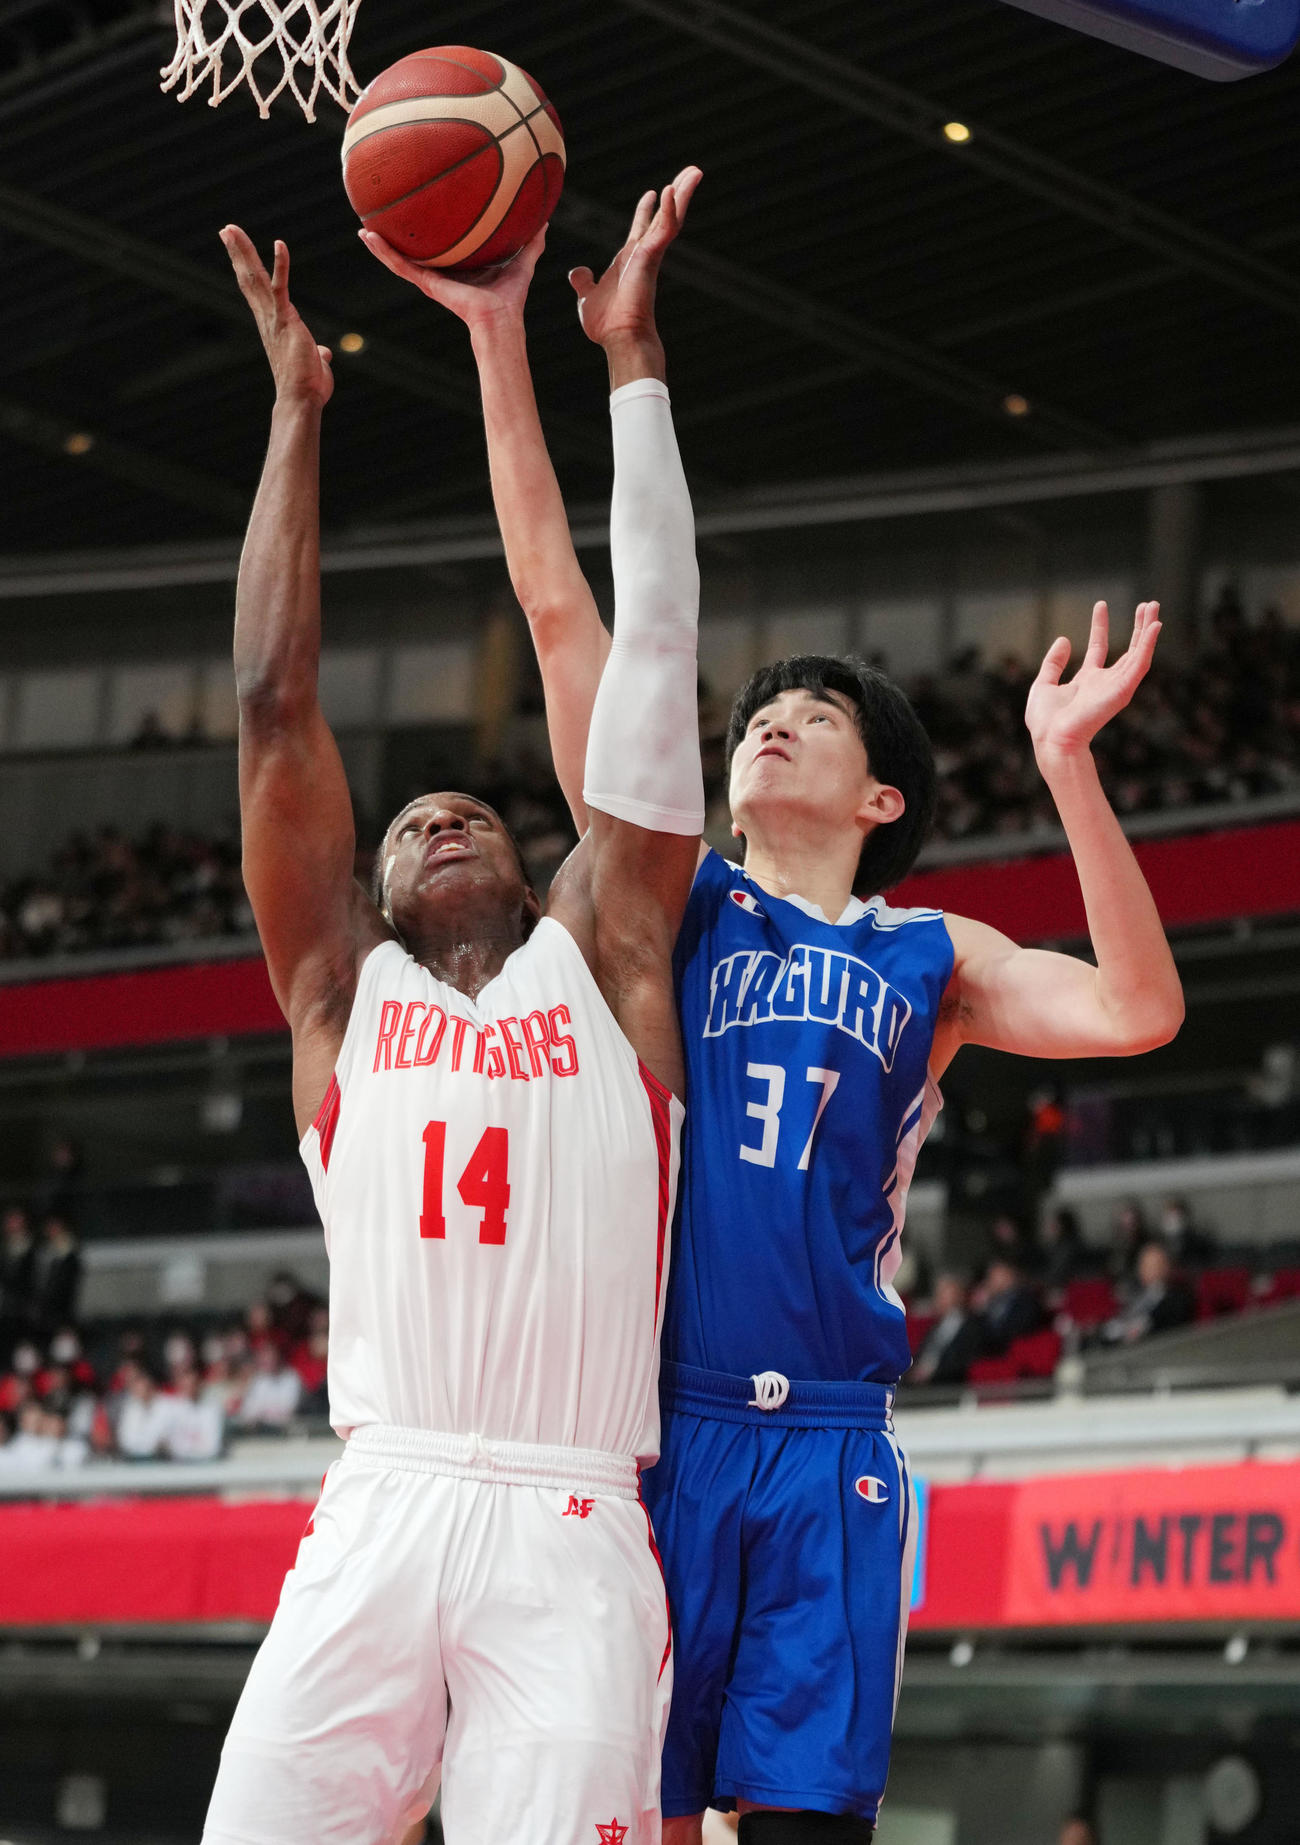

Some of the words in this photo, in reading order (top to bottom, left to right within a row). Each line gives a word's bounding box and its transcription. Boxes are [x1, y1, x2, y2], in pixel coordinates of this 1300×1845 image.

[703, 944, 912, 1074] HAGURO
[739, 1062, 841, 1171] 37
[419, 1120, 511, 1246] 14
